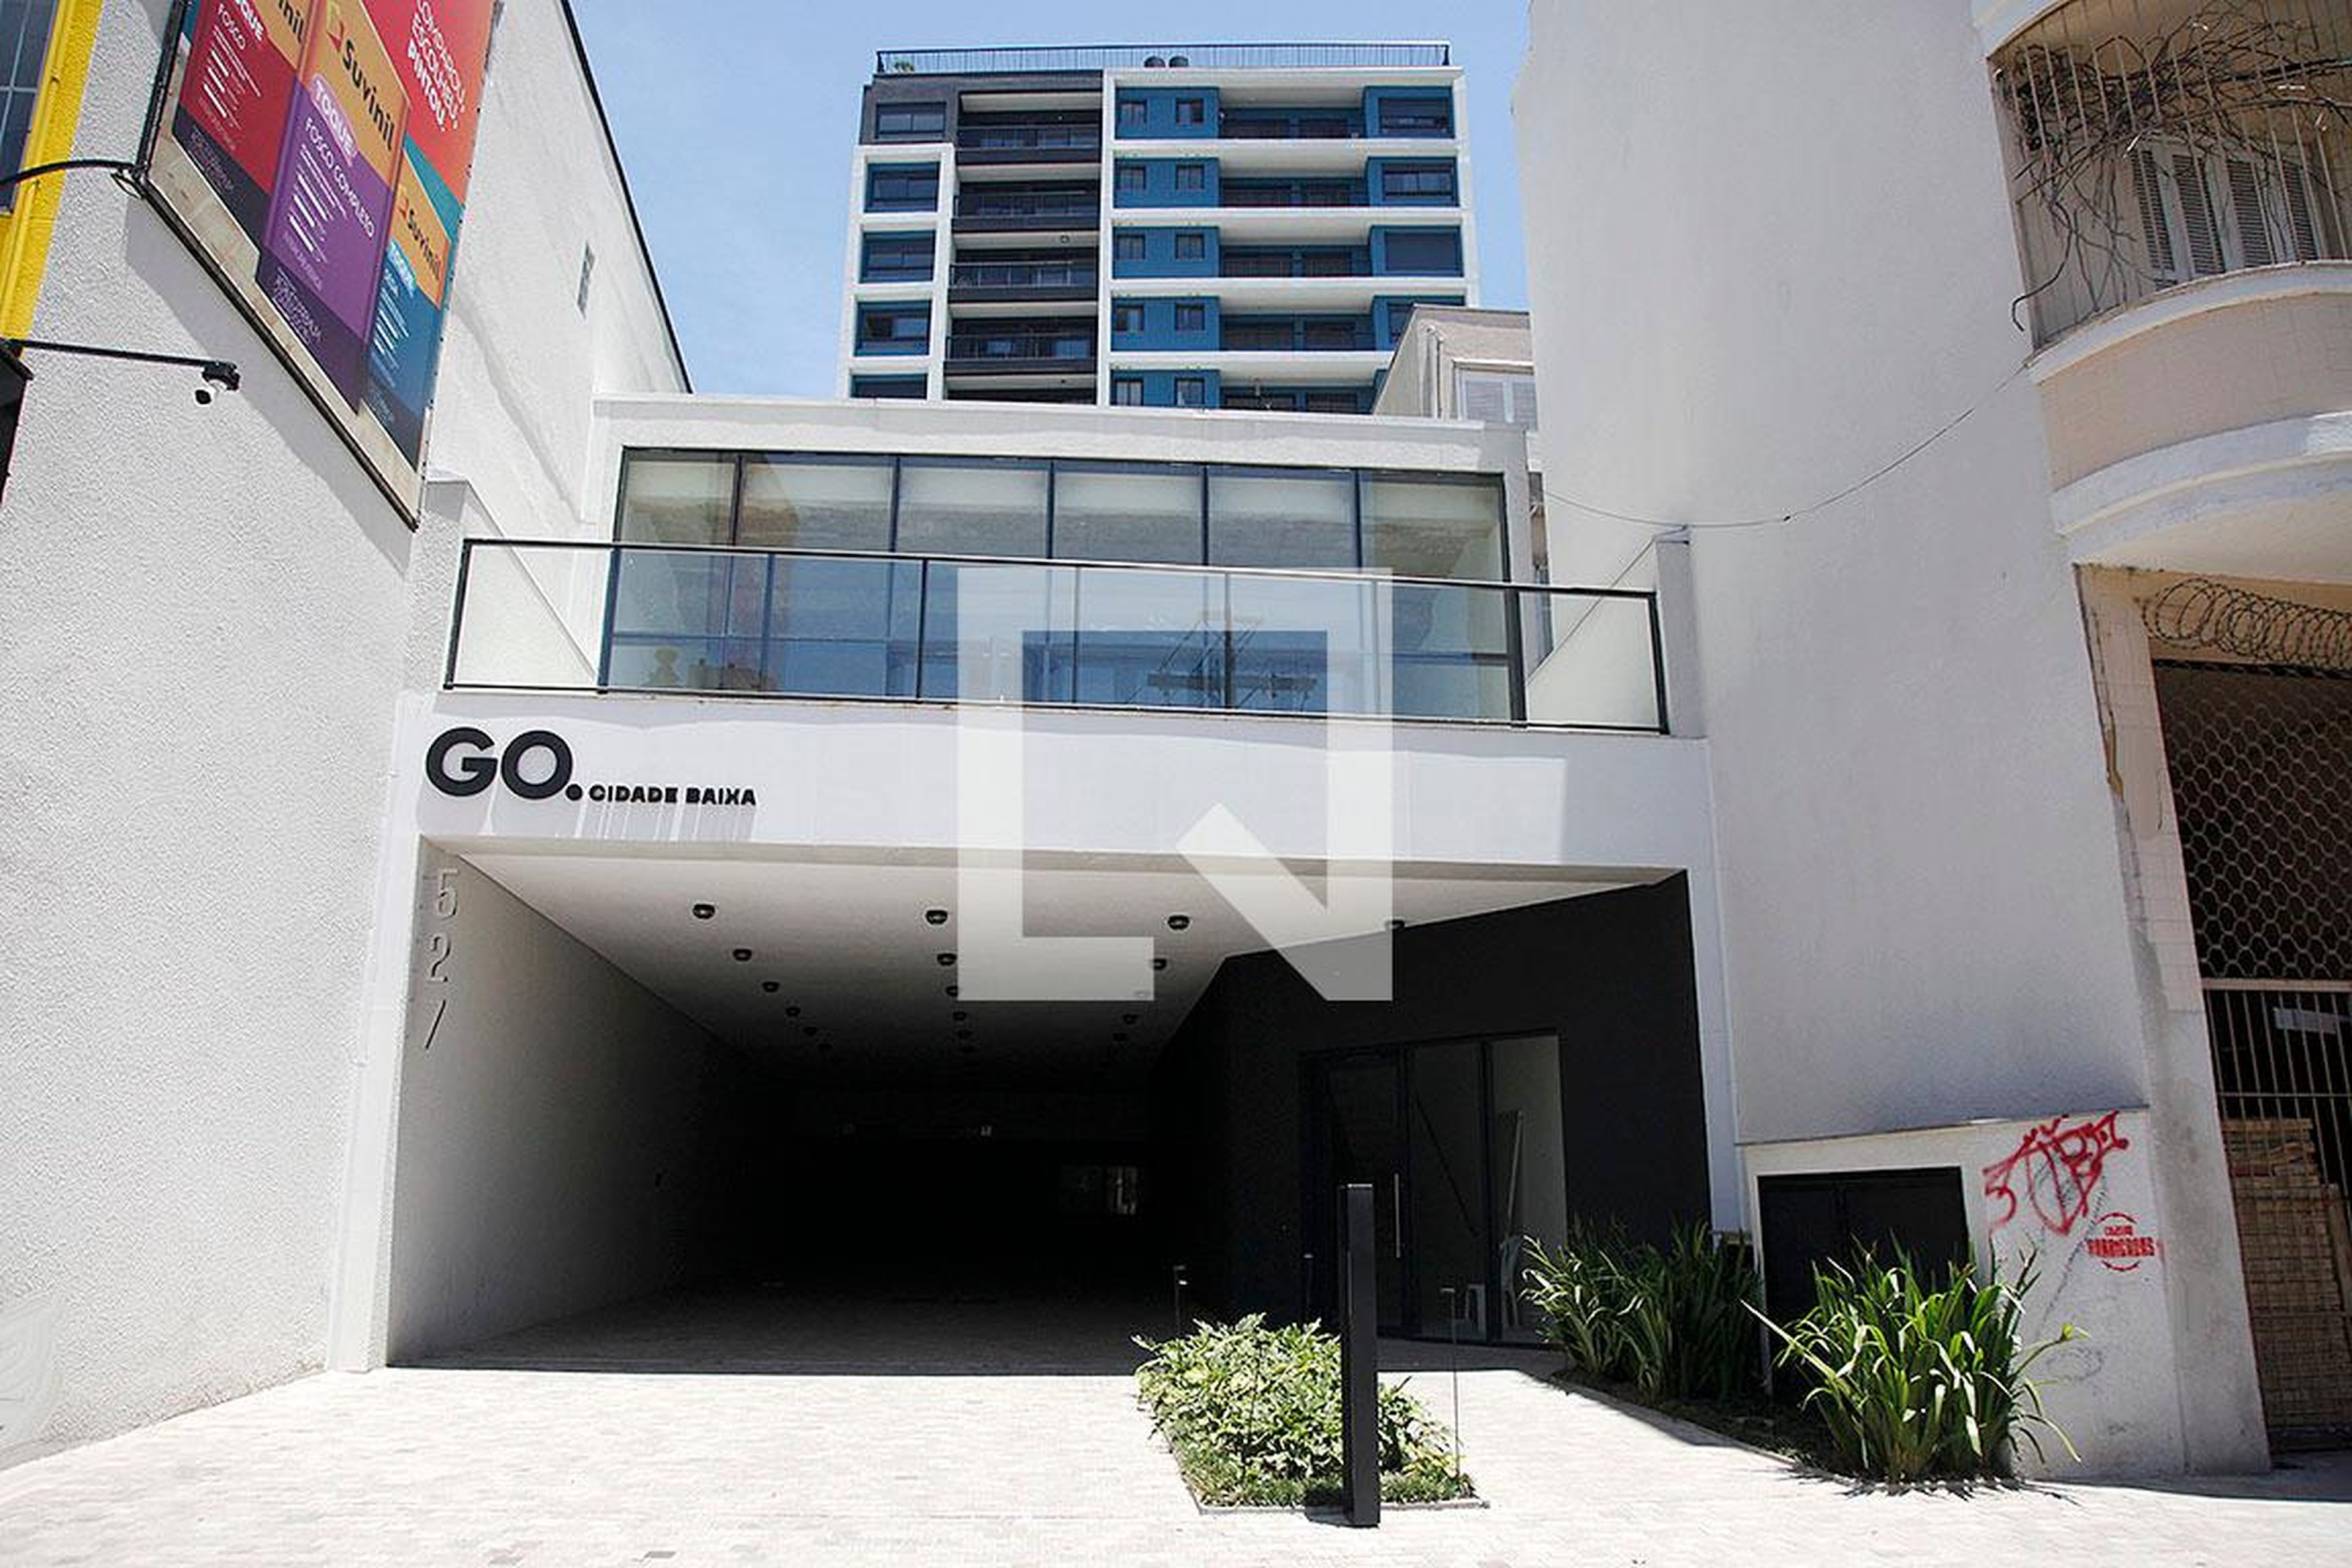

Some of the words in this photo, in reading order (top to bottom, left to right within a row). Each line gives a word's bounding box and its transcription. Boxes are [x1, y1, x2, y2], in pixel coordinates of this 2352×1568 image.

[217, 3, 245, 50] FOSCO
[315, 79, 357, 158] TOQUE
[342, 39, 394, 151] Suvinil
[306, 116, 334, 169] FOSCO
[334, 164, 375, 238] COMPLETO
[407, 209, 442, 281] Suvinil
[426, 726, 582, 801] GO.
[588, 784, 678, 804] CIDADE
[685, 786, 757, 806] BAIXA
